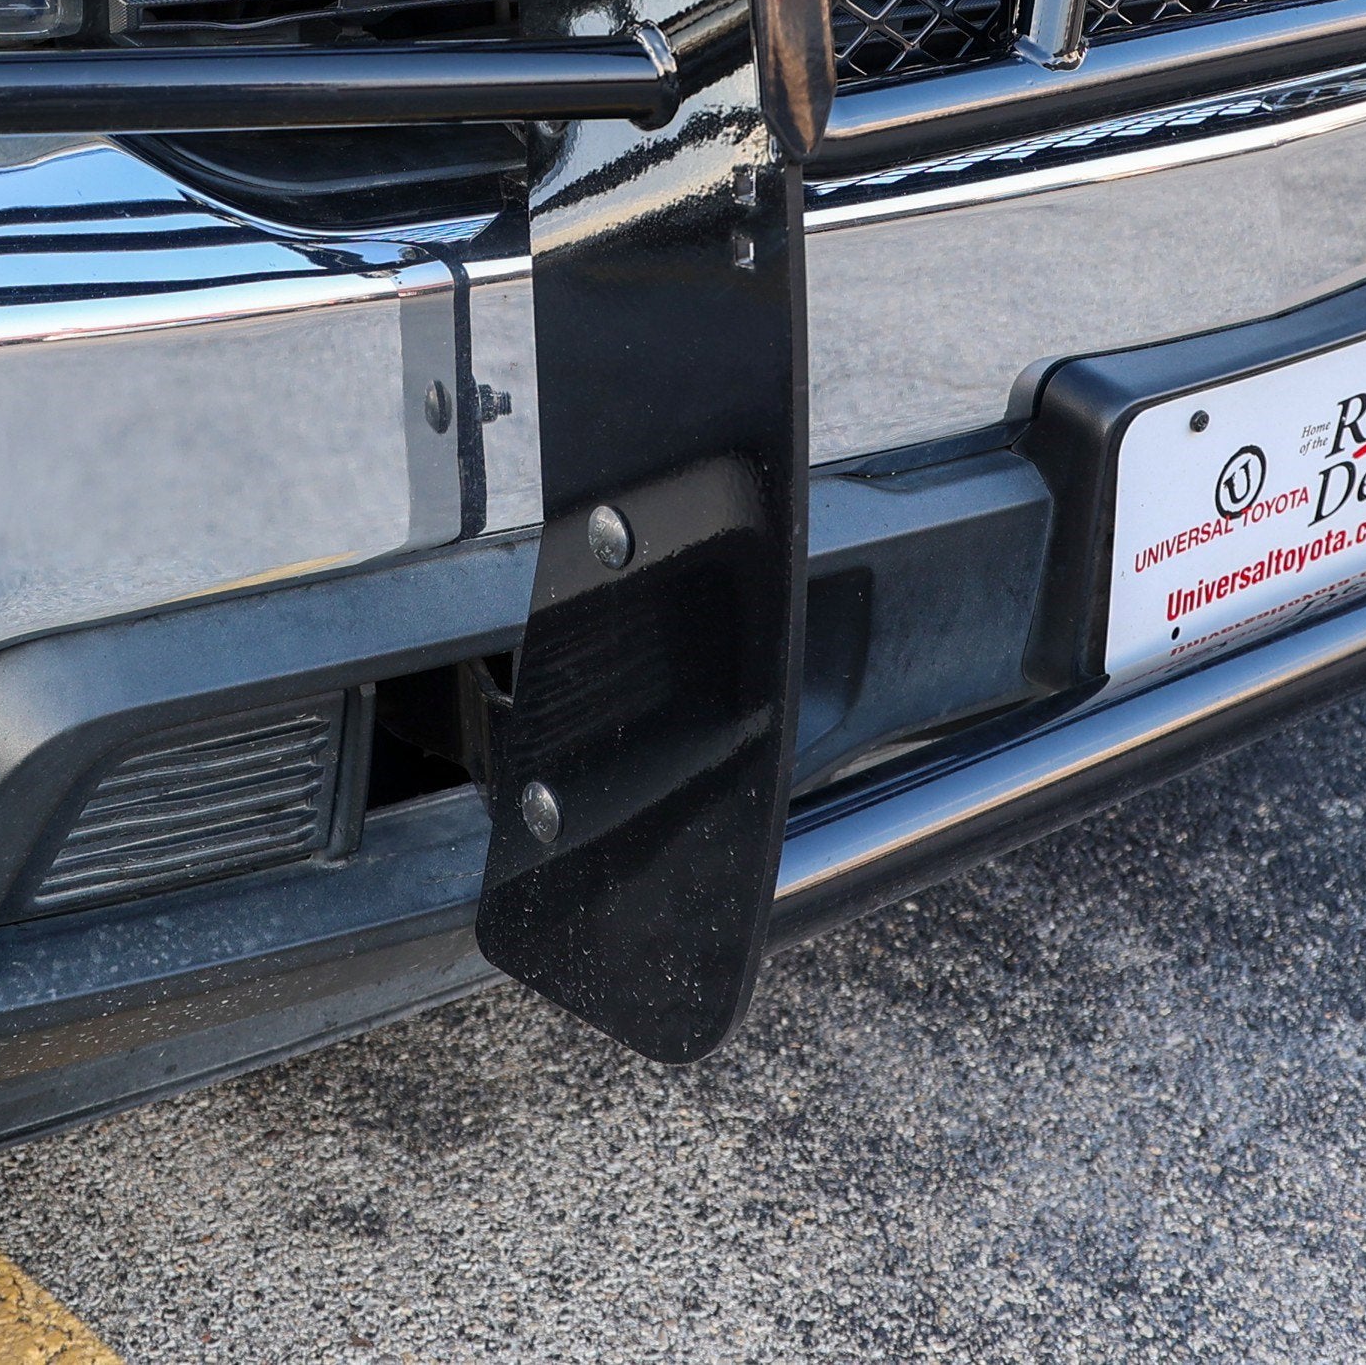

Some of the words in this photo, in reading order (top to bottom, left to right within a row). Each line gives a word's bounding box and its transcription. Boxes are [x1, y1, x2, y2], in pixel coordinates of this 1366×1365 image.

[1301, 421, 1331, 438] Home
[1299, 439, 1312, 456] of
[1312, 436, 1328, 449] the
[1134, 515, 1234, 573] UNIVERSAL
[1240, 486, 1309, 527] TOYOTA
